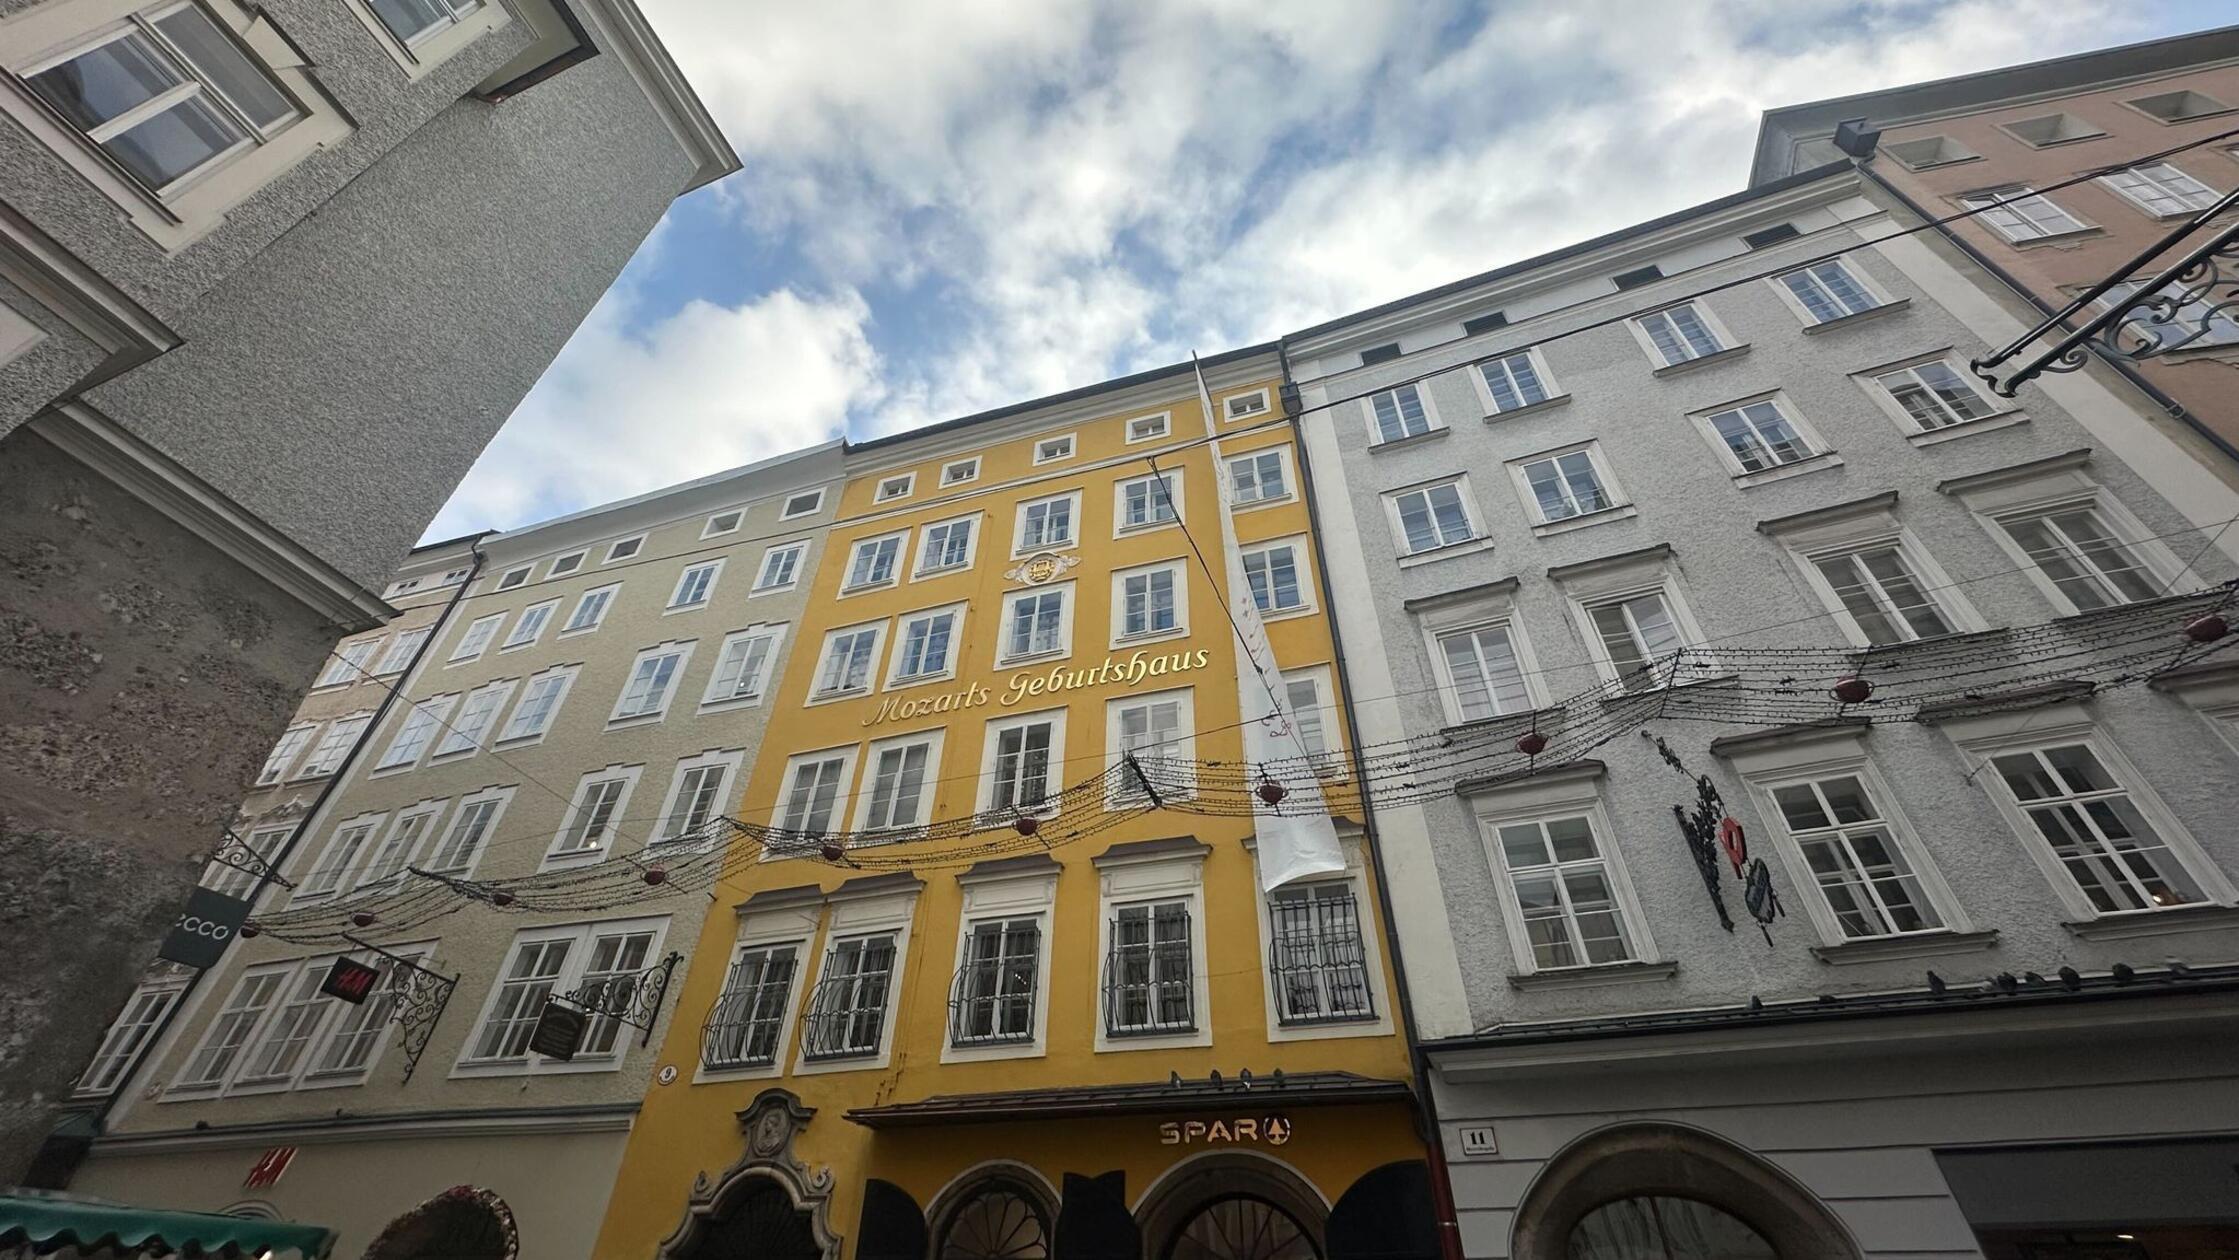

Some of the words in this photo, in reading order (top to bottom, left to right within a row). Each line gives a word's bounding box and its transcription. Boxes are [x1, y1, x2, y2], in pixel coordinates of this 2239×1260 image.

[862, 681, 991, 727] Mozarts
[1000, 648, 1210, 706] Geburtshaus
[664, 1067, 672, 1079] 9
[1159, 1118, 1258, 1145] SPAR
[1470, 1131, 1485, 1145] 11
